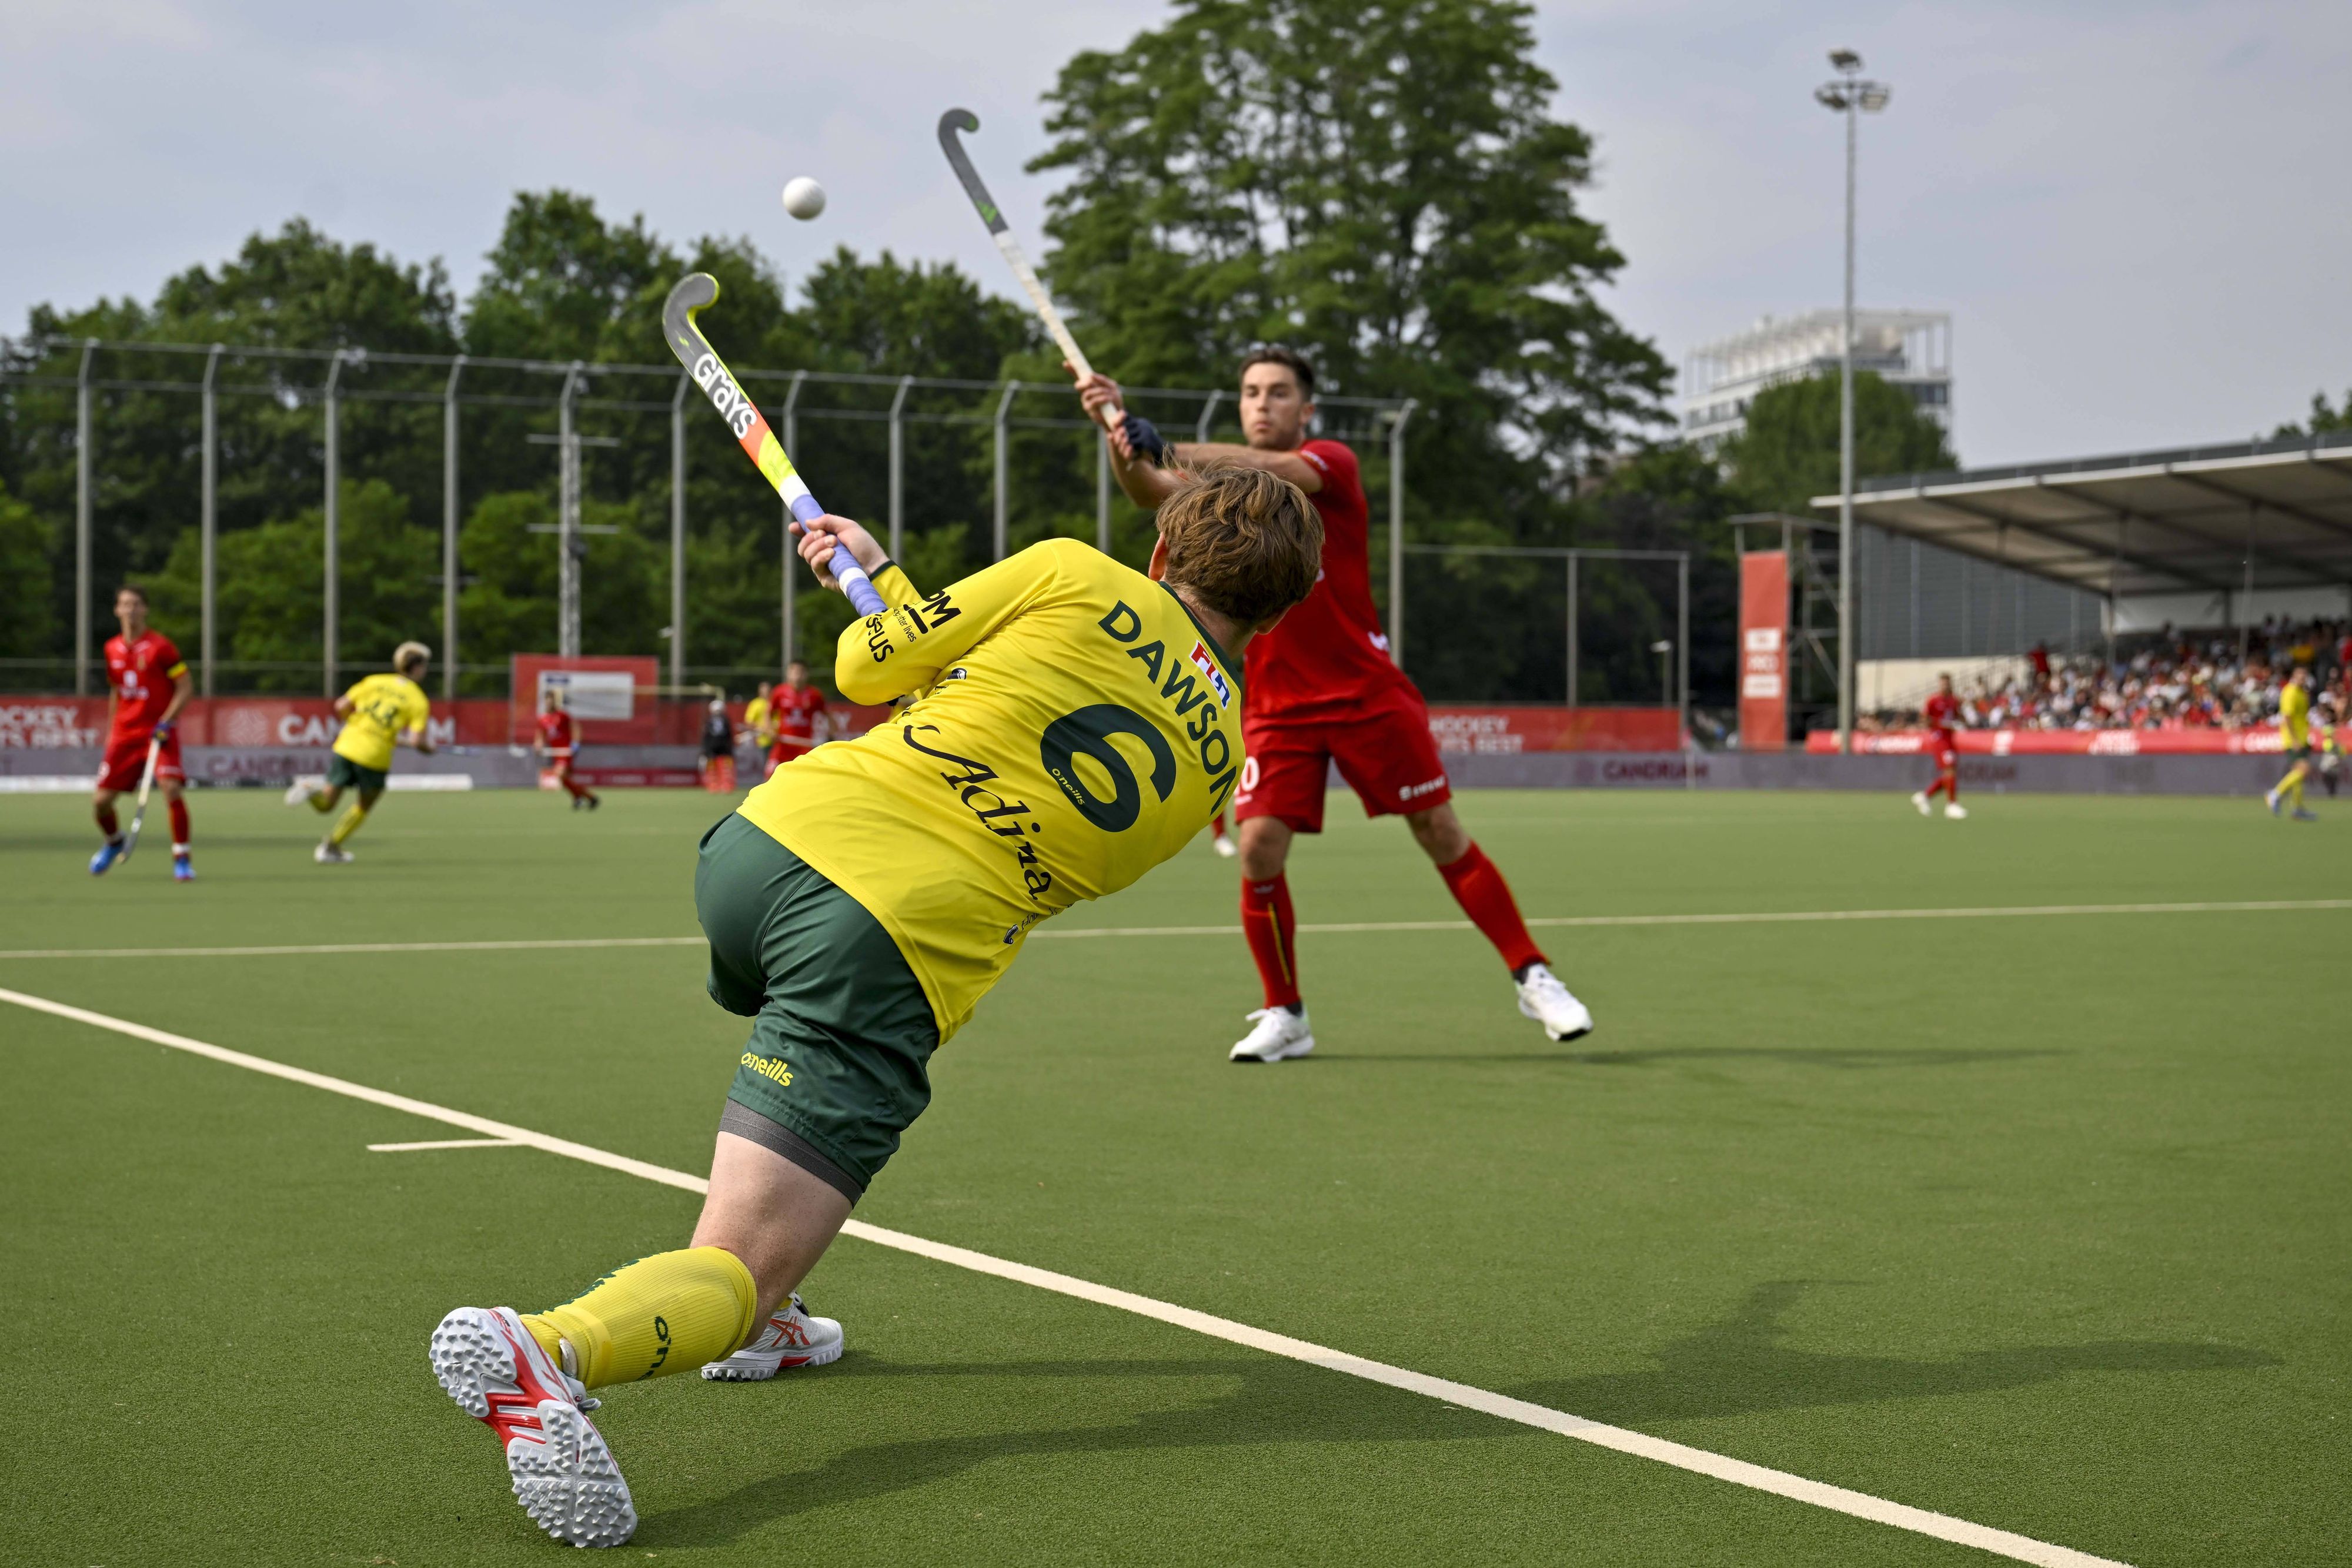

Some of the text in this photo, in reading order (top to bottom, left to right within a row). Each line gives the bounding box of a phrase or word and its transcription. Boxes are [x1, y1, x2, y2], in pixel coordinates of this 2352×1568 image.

[903, 624, 917, 642] lives
[1098, 600, 1236, 816] DAWSON
[903, 725, 1052, 901] Adina
[1040, 704, 1176, 833] 6
